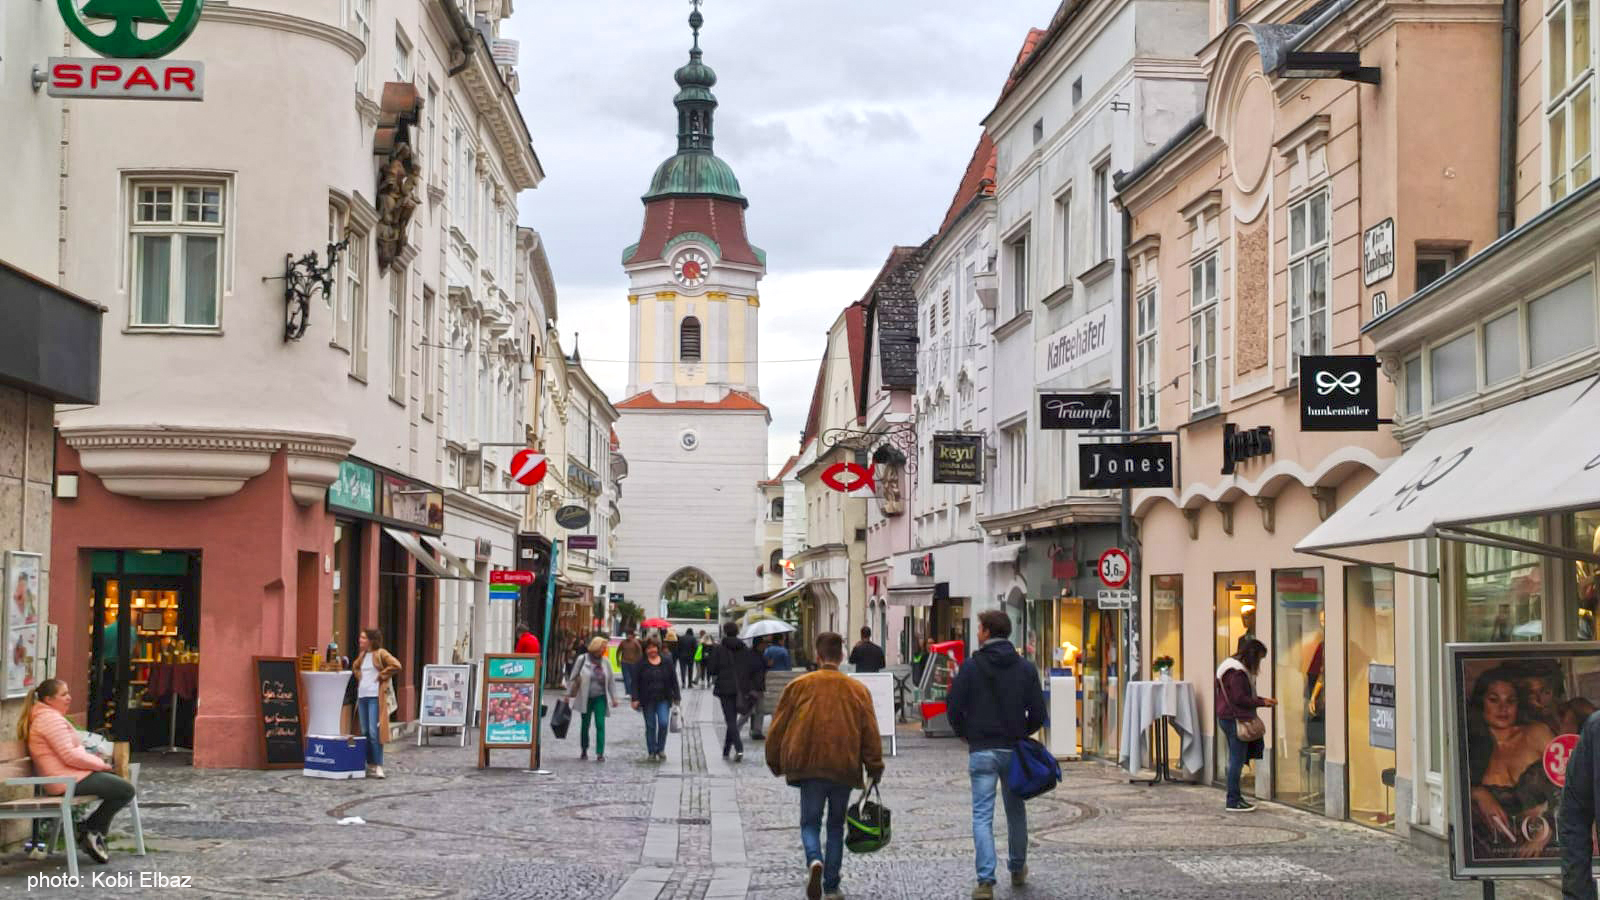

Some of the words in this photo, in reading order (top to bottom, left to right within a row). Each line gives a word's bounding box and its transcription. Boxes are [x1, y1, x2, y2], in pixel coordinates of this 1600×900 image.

[53, 64, 196, 91] SPAR
[1047, 314, 1106, 372] Kaffeehäferl
[1046, 400, 1112, 426] Triumph
[1307, 406, 1369, 417] hunkemöller
[1089, 453, 1165, 478] Jones
[504, 573, 531, 582] Banking
[1372, 709, 1393, 729] -20%
[314, 743, 326, 755] XL
[1491, 815, 1561, 844] NO
